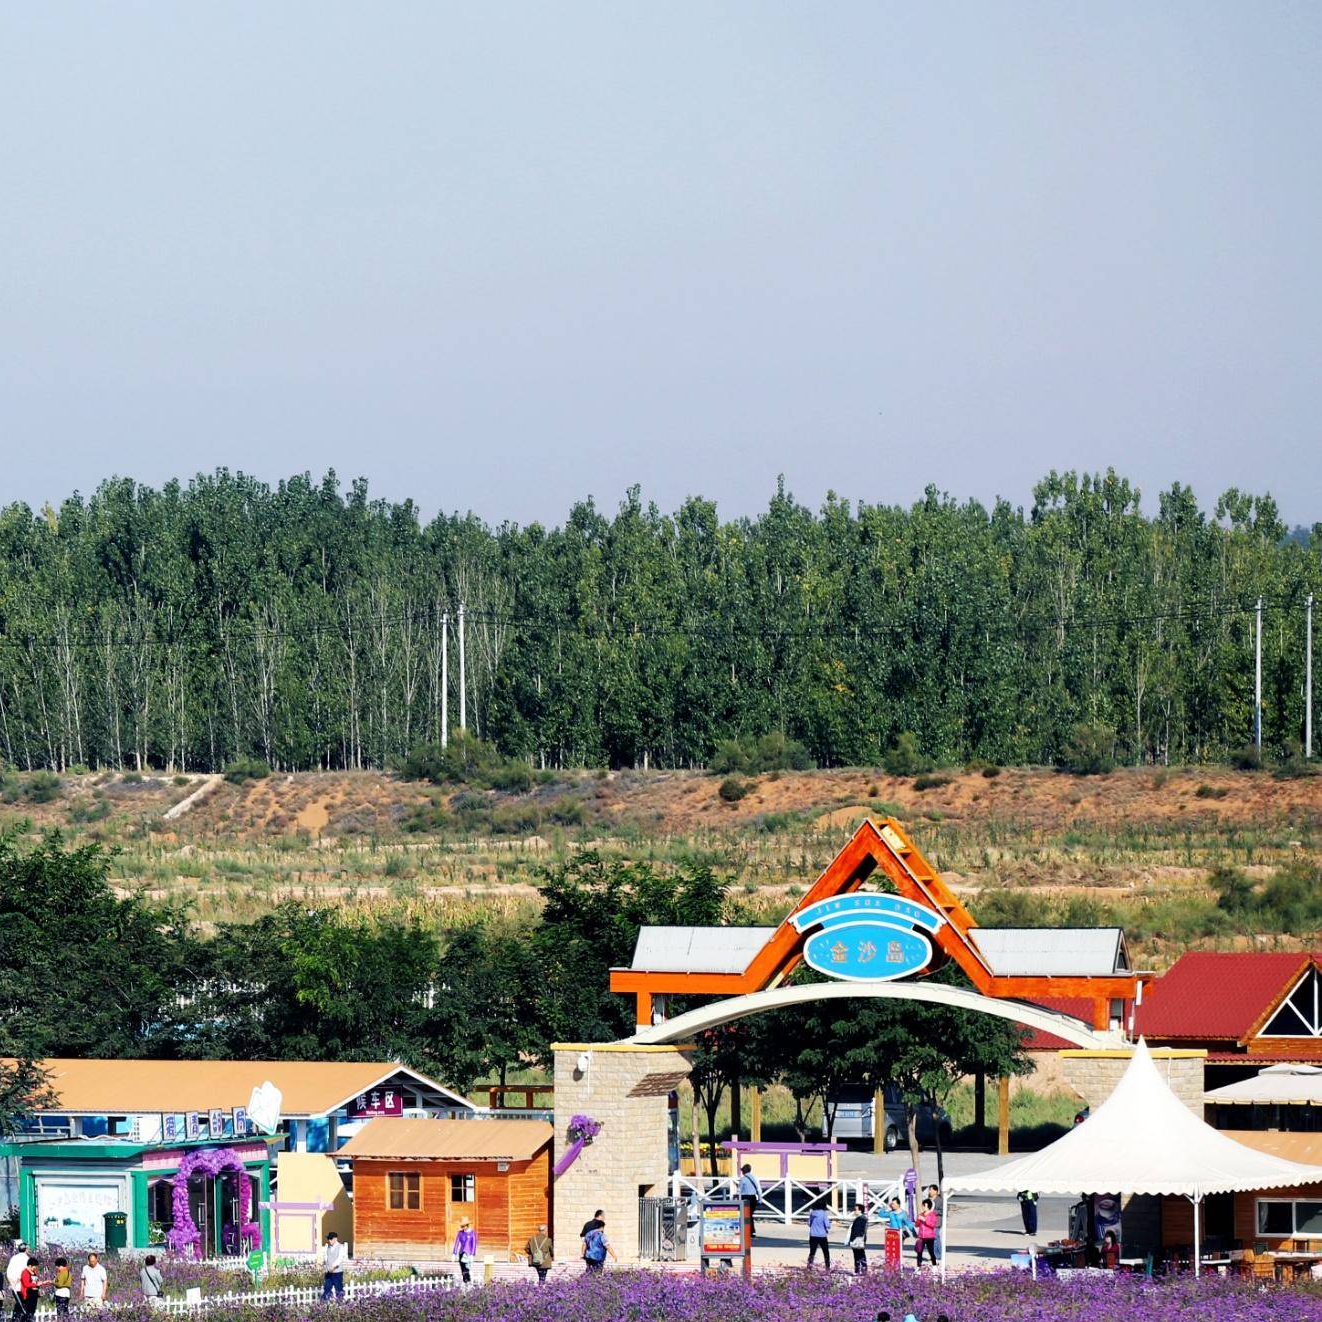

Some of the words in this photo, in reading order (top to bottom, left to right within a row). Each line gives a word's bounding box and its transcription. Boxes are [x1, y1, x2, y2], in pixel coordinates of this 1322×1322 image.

[830, 941, 905, 963] 金沙岛
[356, 1091, 395, 1110] 候车区
